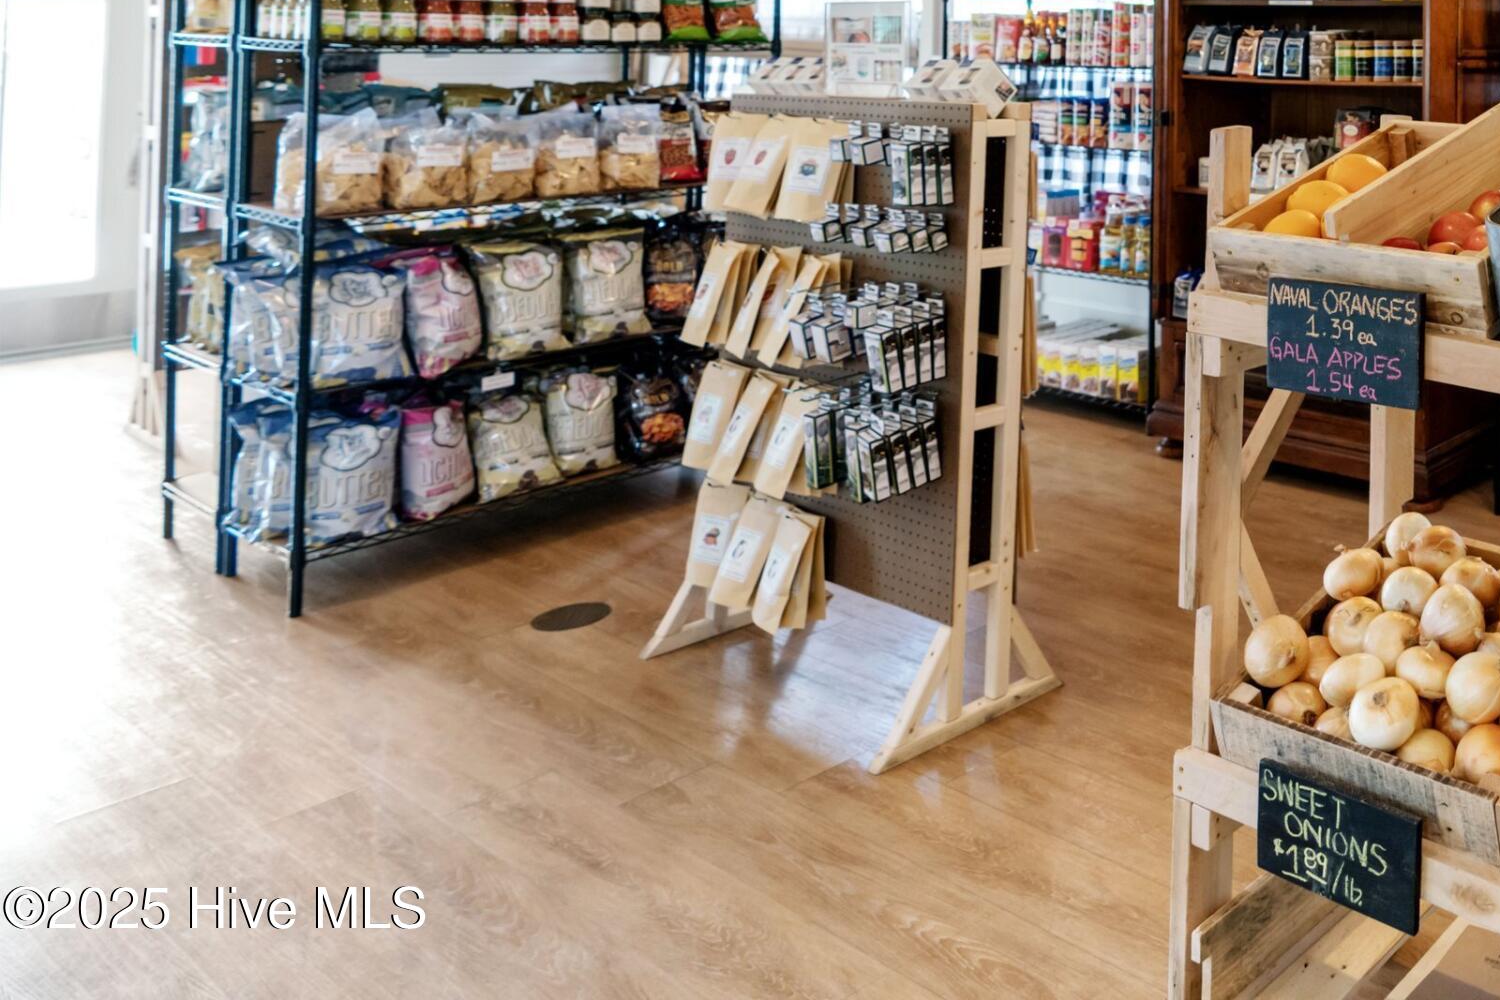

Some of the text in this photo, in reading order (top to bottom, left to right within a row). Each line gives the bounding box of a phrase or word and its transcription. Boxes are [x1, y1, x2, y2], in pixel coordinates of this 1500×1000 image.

[1269, 282, 1418, 325] NAVAL ORANGES
[1305, 314, 1378, 347] 1.39 ea
[1270, 336, 1403, 381] GALA APPLES
[1306, 368, 1377, 401] 1.54 ea
[1263, 768, 1346, 830] SWEET
[1284, 811, 1388, 877] ONIONS
